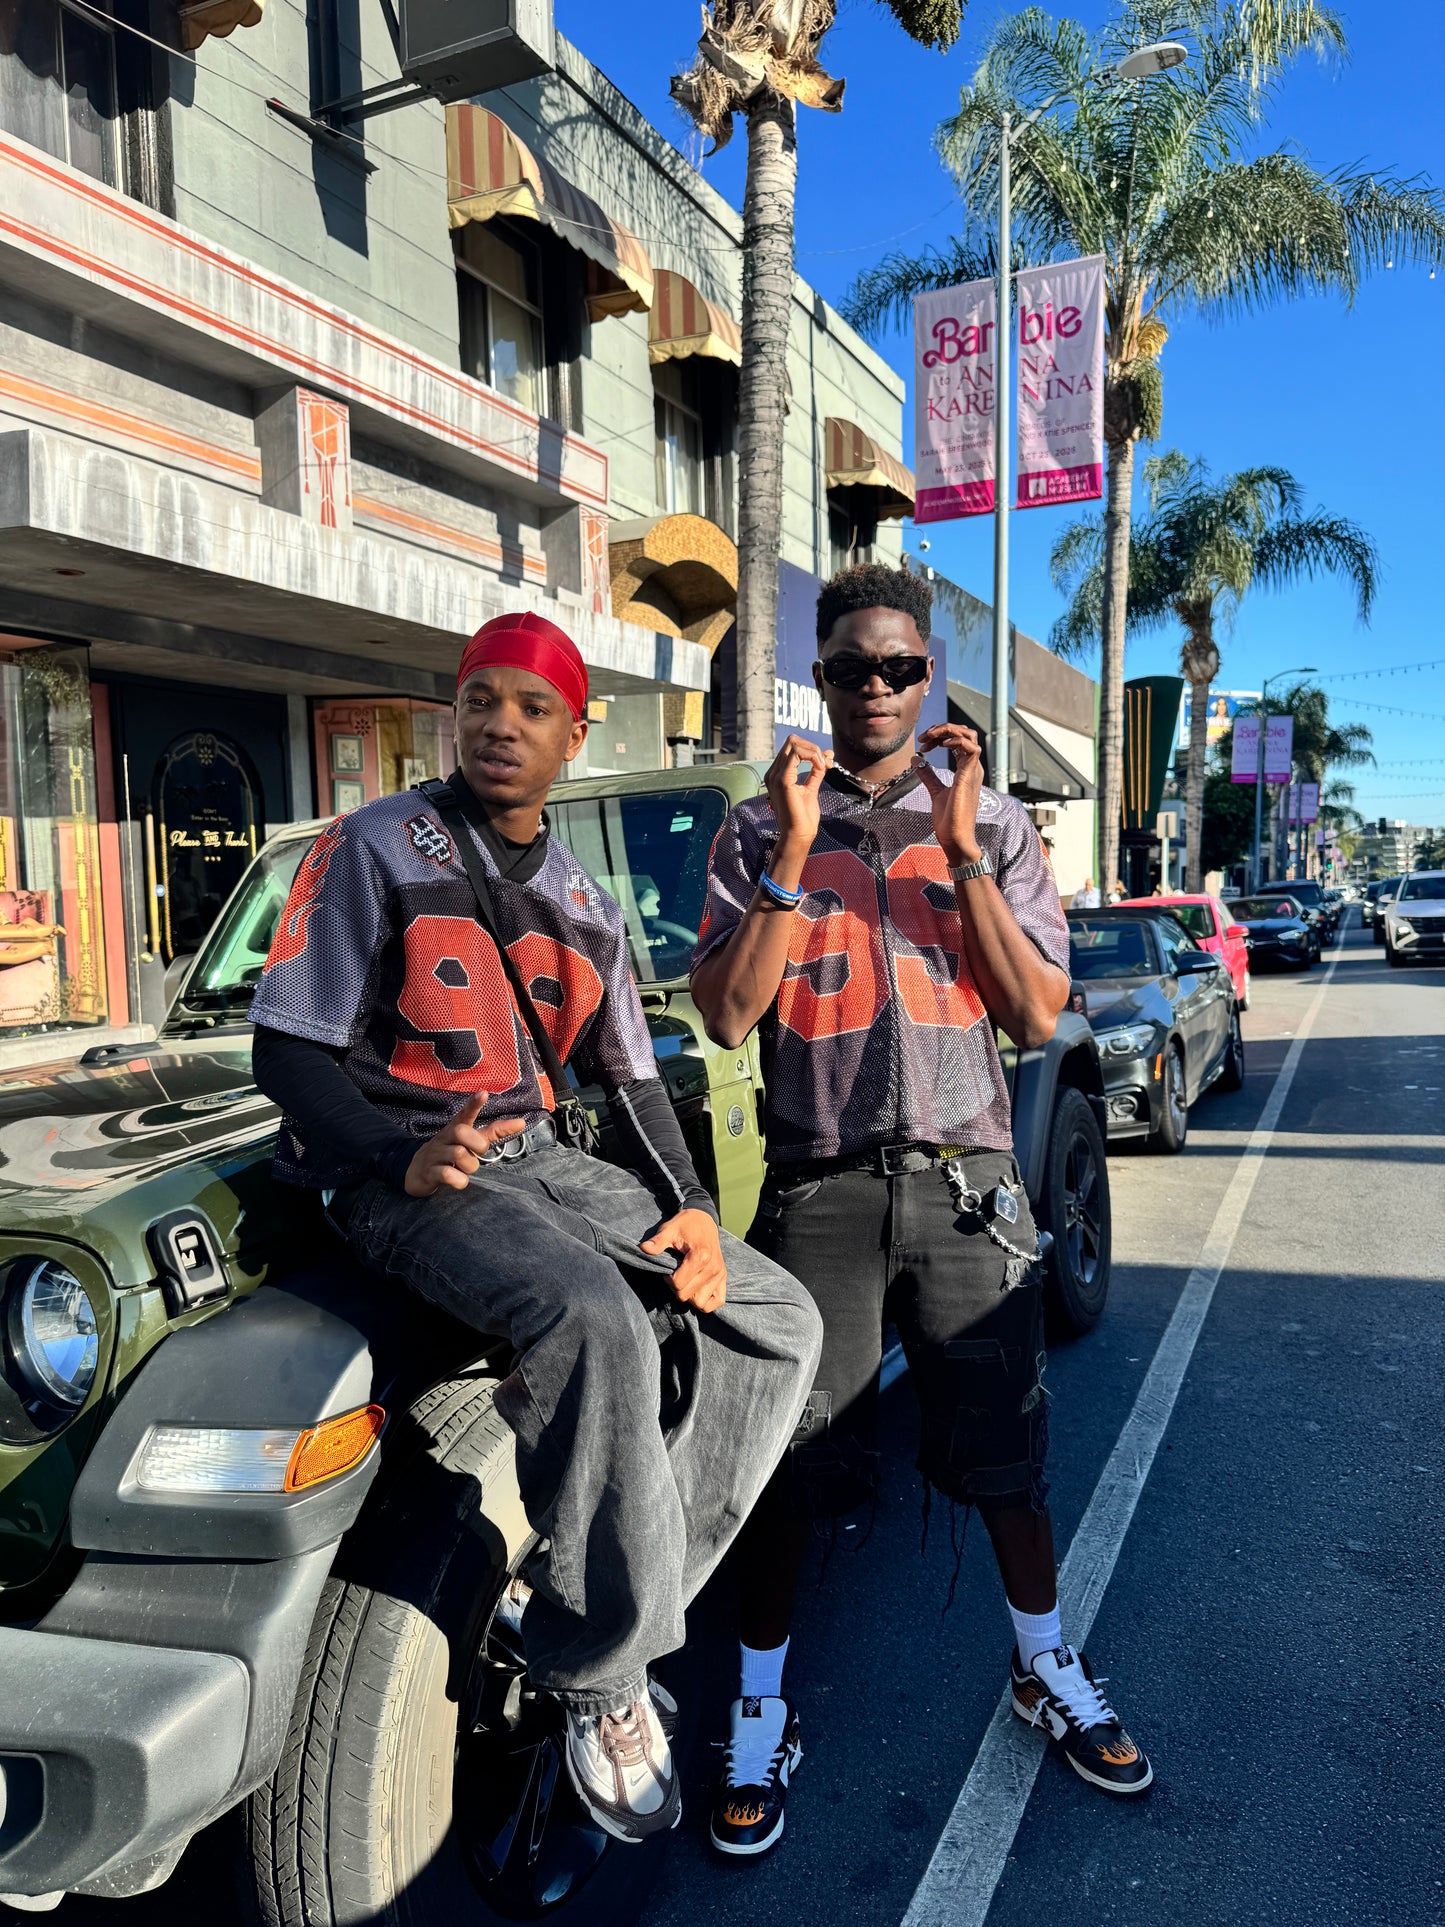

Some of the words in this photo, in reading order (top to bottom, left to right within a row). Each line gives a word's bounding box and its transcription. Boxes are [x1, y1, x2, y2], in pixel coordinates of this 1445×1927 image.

[1020, 303, 1083, 345] bie
[923, 317, 995, 370] Bar
[940, 376, 951, 387] to
[957, 363, 994, 391] AN
[1021, 355, 1060, 378] NA
[1022, 373, 1094, 405] NINA
[927, 391, 995, 423] KARE
[775, 678, 821, 733] ELBOW
[169, 830, 201, 847] Please
[223, 831, 250, 847] Thanks
